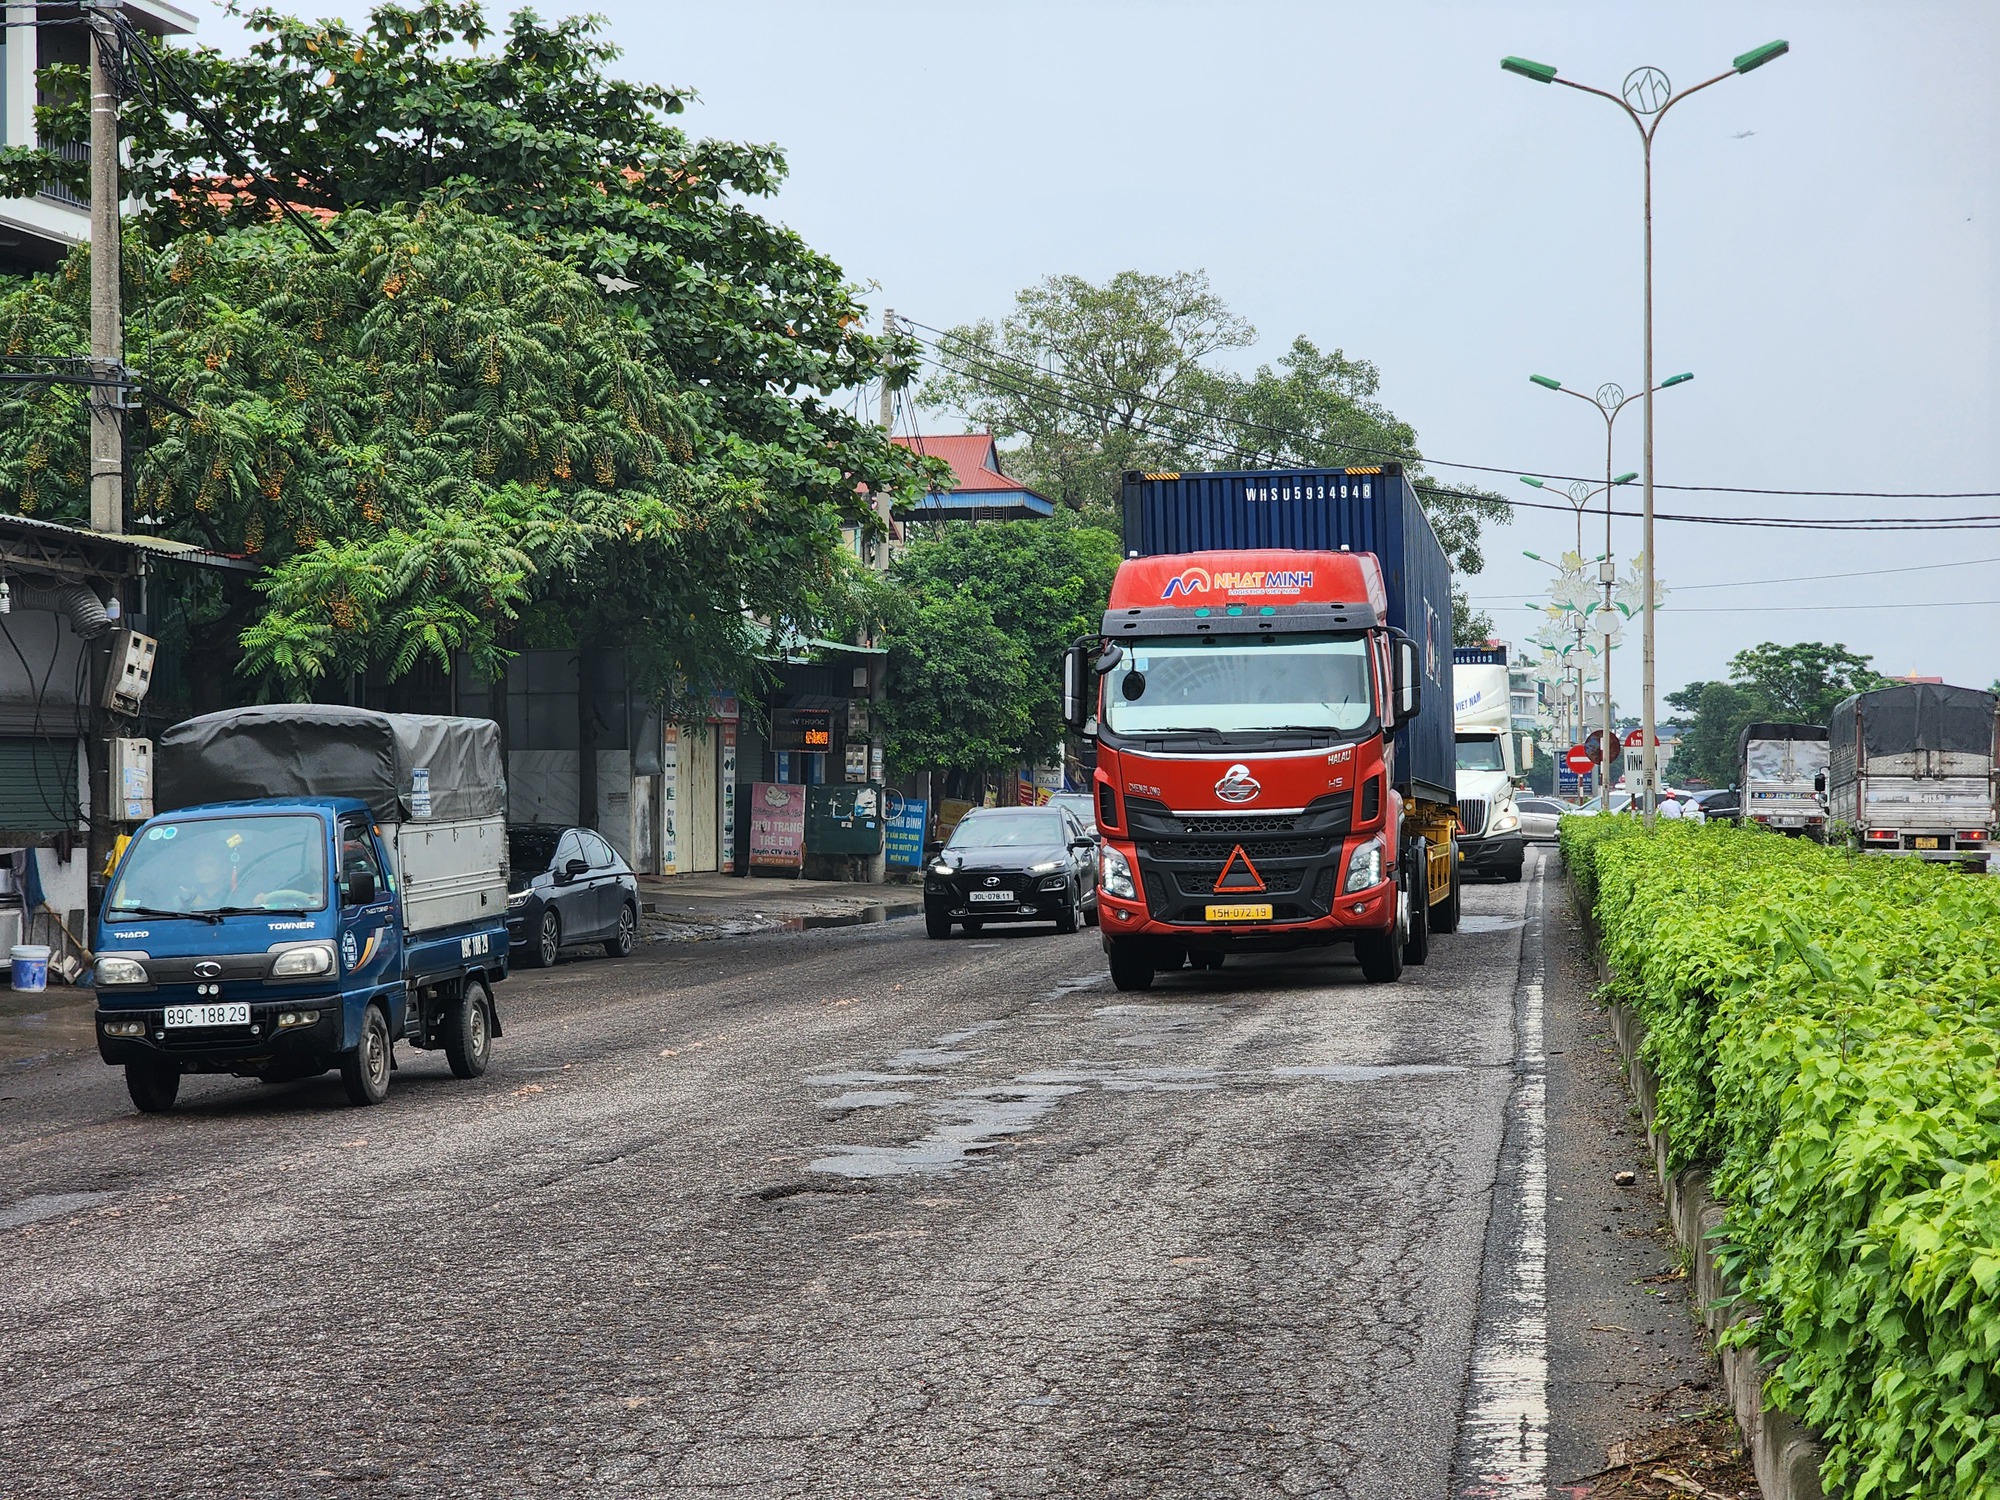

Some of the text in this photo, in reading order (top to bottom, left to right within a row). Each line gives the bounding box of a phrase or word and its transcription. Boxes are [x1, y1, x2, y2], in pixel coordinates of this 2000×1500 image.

[1265, 571, 1313, 588] MINH
[1228, 588, 1265, 596] LOGISTICS
[1282, 587, 1301, 595] NAM
[1469, 690, 1482, 706] NAM
[1630, 737, 1642, 746] km
[1626, 750, 1643, 771] VĨNH
[773, 821, 803, 833] TRANG
[778, 836, 793, 847] EM
[1212, 907, 1267, 918] 15H-072.19
[267, 921, 315, 931] TOWNER
[114, 931, 150, 939] THACO
[167, 1006, 247, 1025] 89C-188.29
